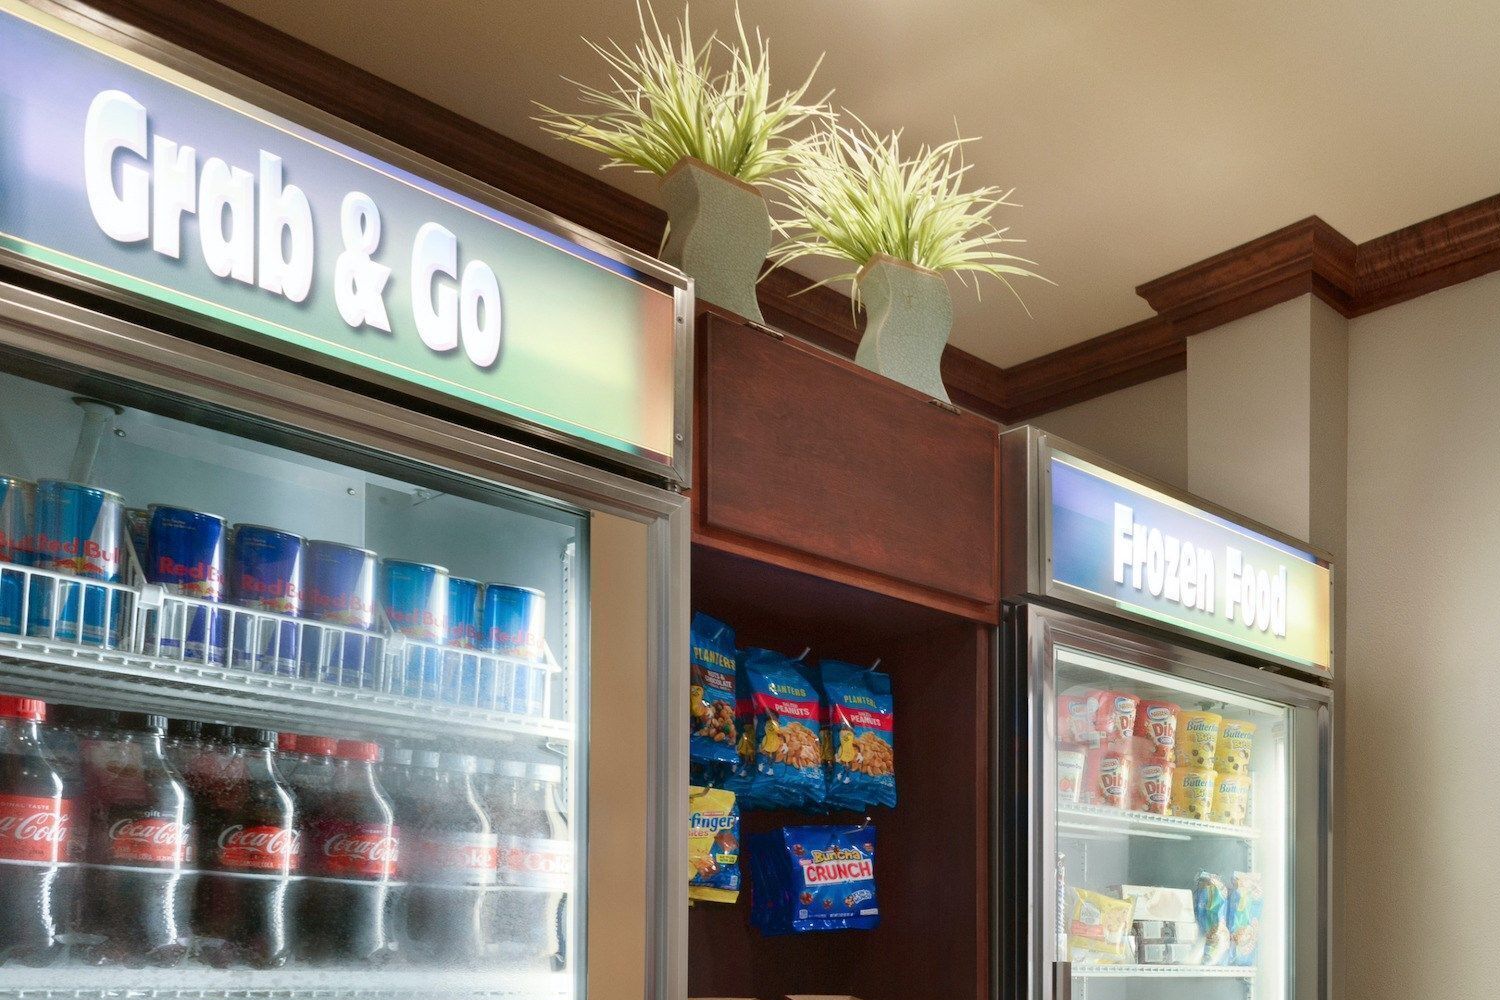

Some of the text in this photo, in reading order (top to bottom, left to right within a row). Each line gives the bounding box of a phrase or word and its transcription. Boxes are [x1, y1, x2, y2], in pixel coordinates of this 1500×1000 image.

[83, 89, 501, 368] Grab & Go
[1113, 501, 1288, 638] Frozen Food
[775, 703, 810, 716] PEANUTS
[850, 714, 882, 727] PEANUTS
[688, 812, 734, 831] finger
[806, 861, 872, 882] CRUNCH
